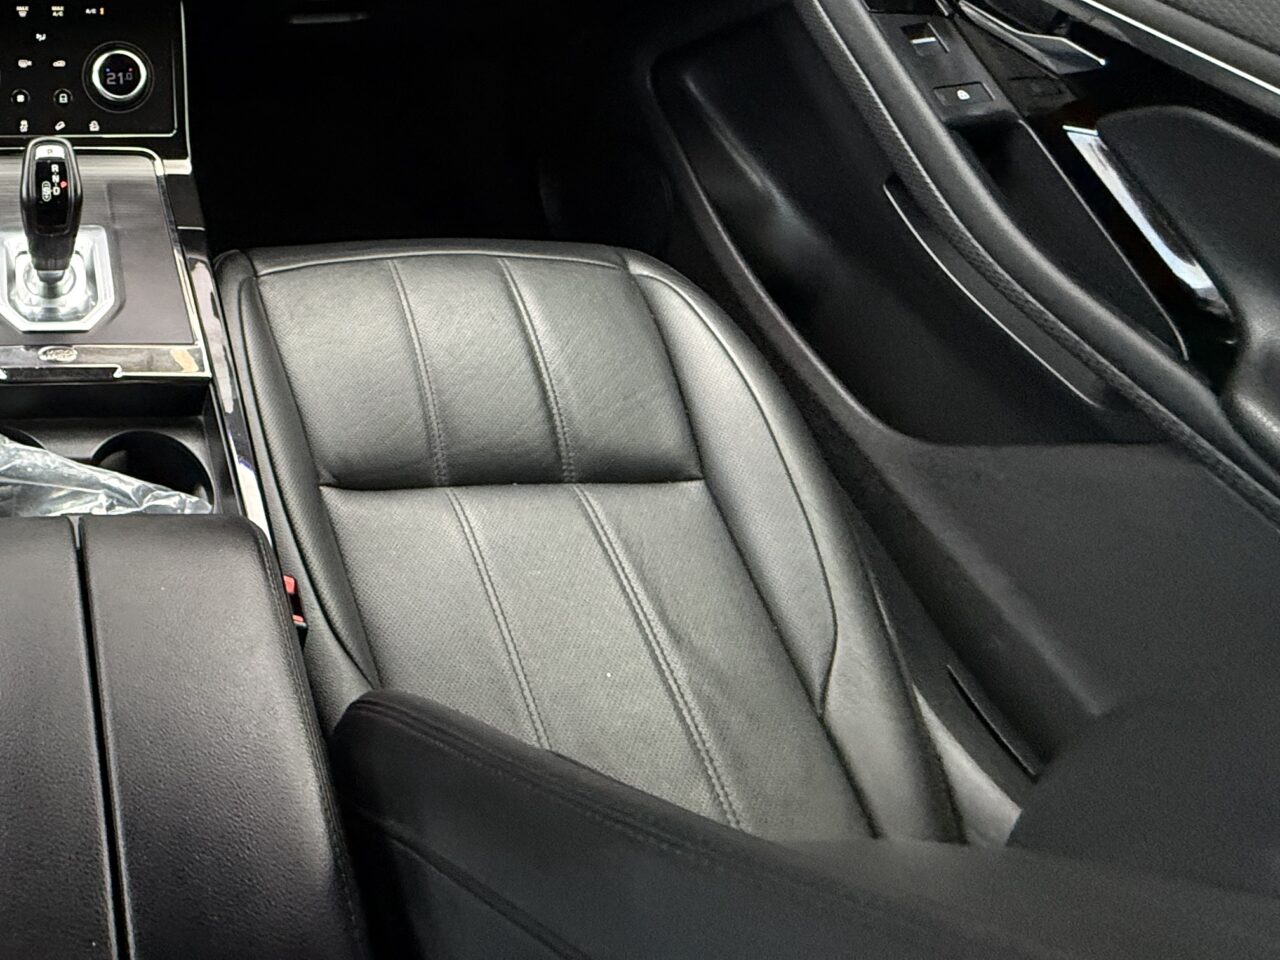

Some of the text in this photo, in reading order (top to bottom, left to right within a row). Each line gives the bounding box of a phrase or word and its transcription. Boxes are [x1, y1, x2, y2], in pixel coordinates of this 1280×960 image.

[106, 72, 133, 85] 21.0
[51, 164, 59, 173] R
[52, 175, 60, 183] N
[53, 186, 61, 195] D
